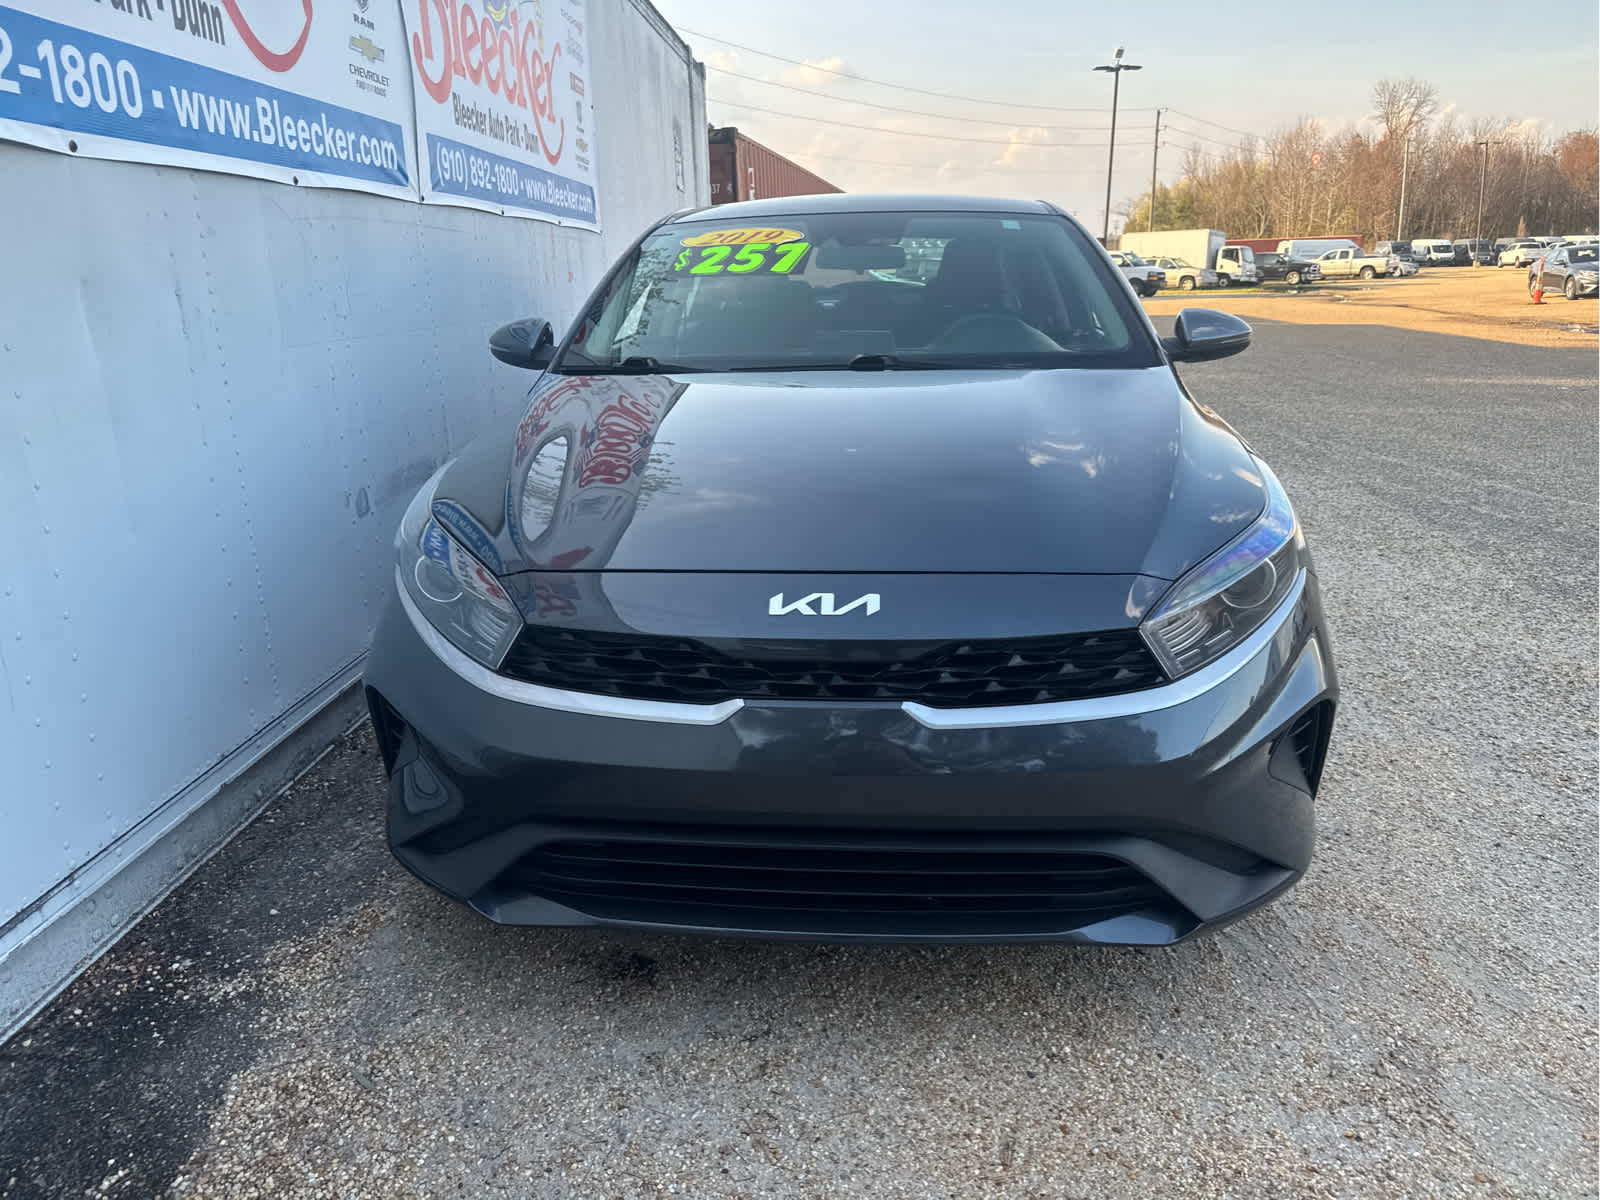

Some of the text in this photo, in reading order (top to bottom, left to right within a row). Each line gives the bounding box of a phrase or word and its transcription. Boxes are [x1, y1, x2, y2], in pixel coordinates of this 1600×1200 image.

[170, 0, 225, 46] Dunn
[353, 13, 375, 31] RAM
[349, 63, 390, 87] CHEVROLET
[169, 85, 399, 170] www.Bleecker.com
[452, 91, 487, 136] Bleecker
[488, 107, 505, 142] Auto
[504, 114, 521, 149] Park
[436, 142, 593, 214] (910) 892-1800 www.Bleecker.com
[697, 230, 785, 245] 2019
[768, 592, 881, 616] KIA
